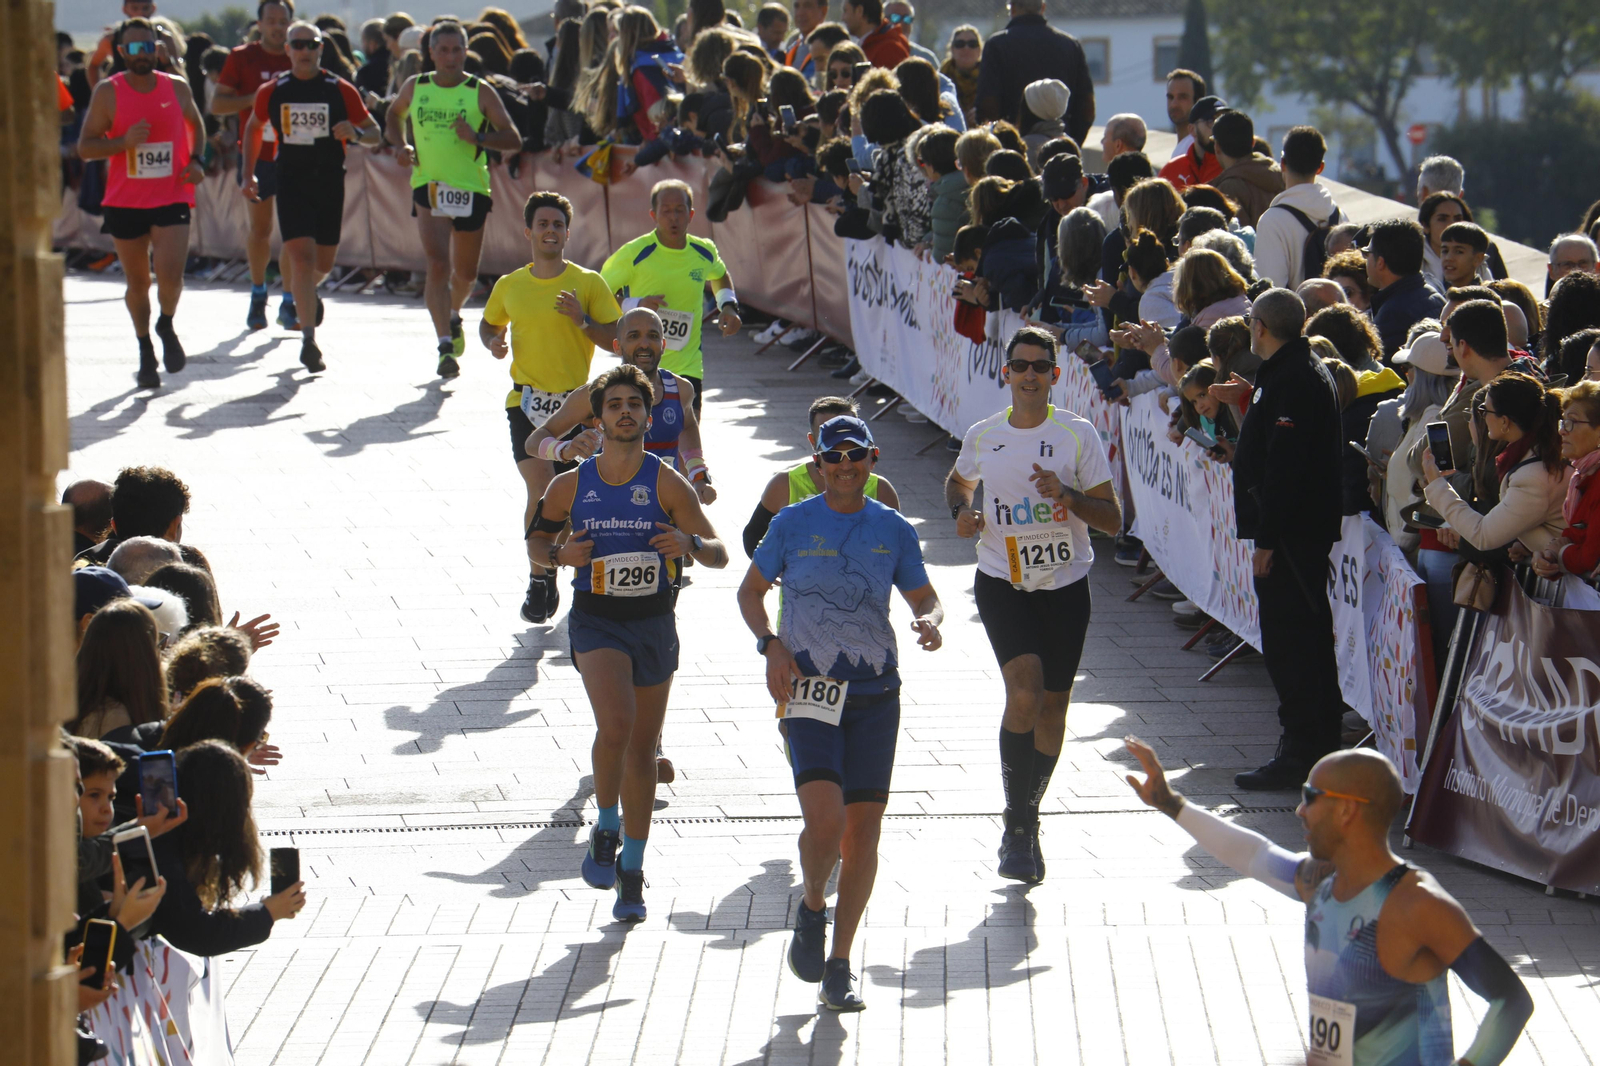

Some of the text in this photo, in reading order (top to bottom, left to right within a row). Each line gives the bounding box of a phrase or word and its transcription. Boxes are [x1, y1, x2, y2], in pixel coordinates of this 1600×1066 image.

[291, 112, 326, 126] 2359
[137, 150, 171, 166] 1944
[438, 190, 470, 206] 1099
[583, 517, 652, 530] Tirabuzón
[1023, 533, 1050, 541] IMDECO
[612, 555, 640, 564] IMDECO
[1020, 541, 1071, 566] 1216
[606, 565, 656, 587] 1296
[1341, 554, 1358, 608] ES
[792, 679, 841, 706] 1180
[1443, 758, 1487, 802] Instituto
